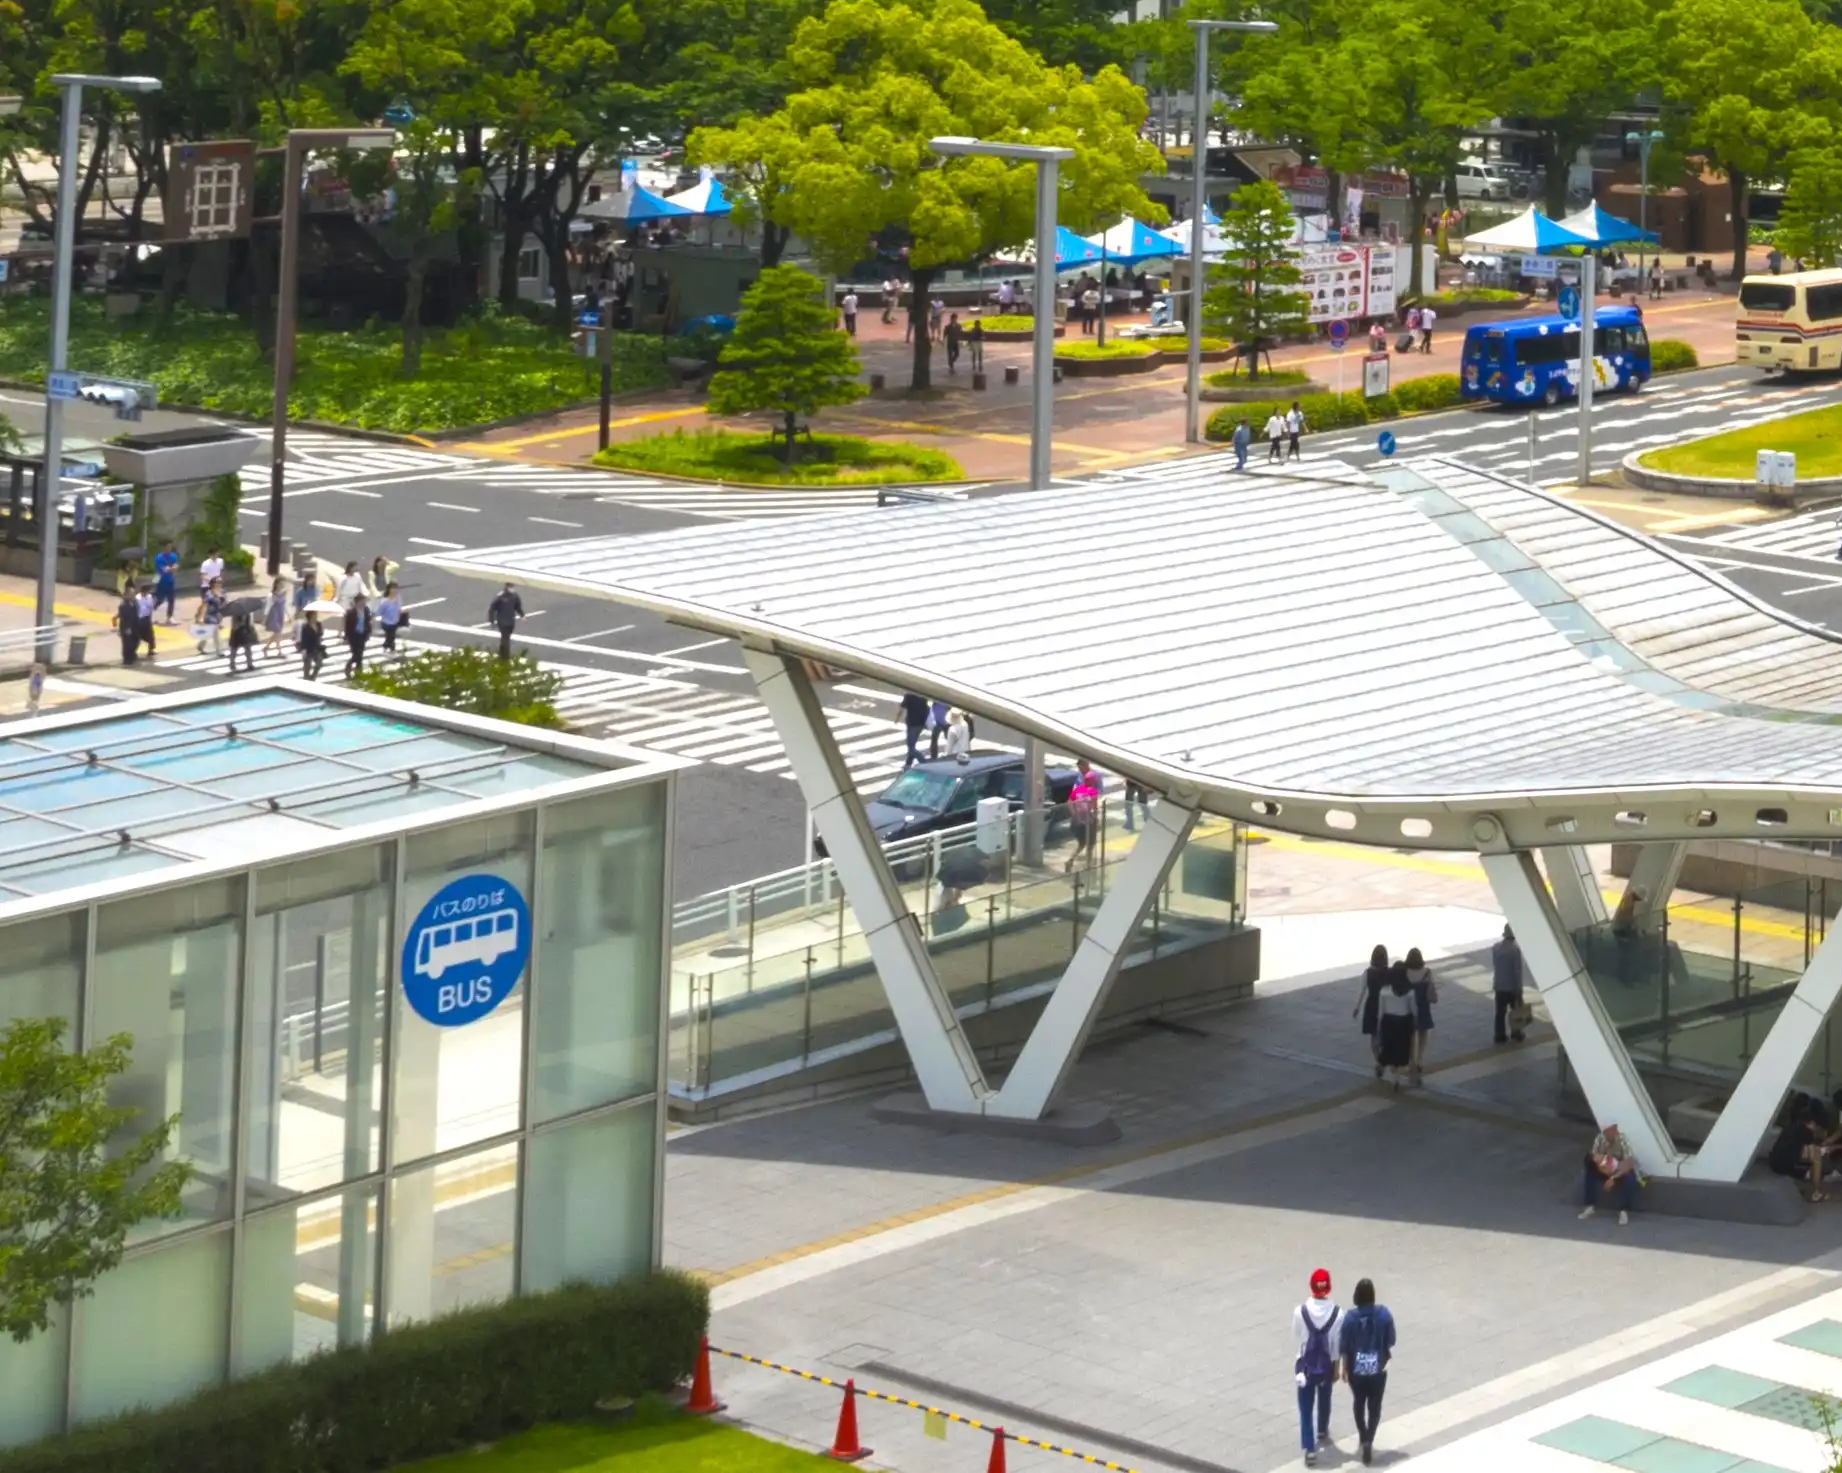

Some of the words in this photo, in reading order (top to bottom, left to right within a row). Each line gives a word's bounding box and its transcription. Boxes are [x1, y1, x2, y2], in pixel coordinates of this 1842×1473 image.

[433, 889, 505, 922] バスのりば
[437, 976, 493, 1014] BUS
